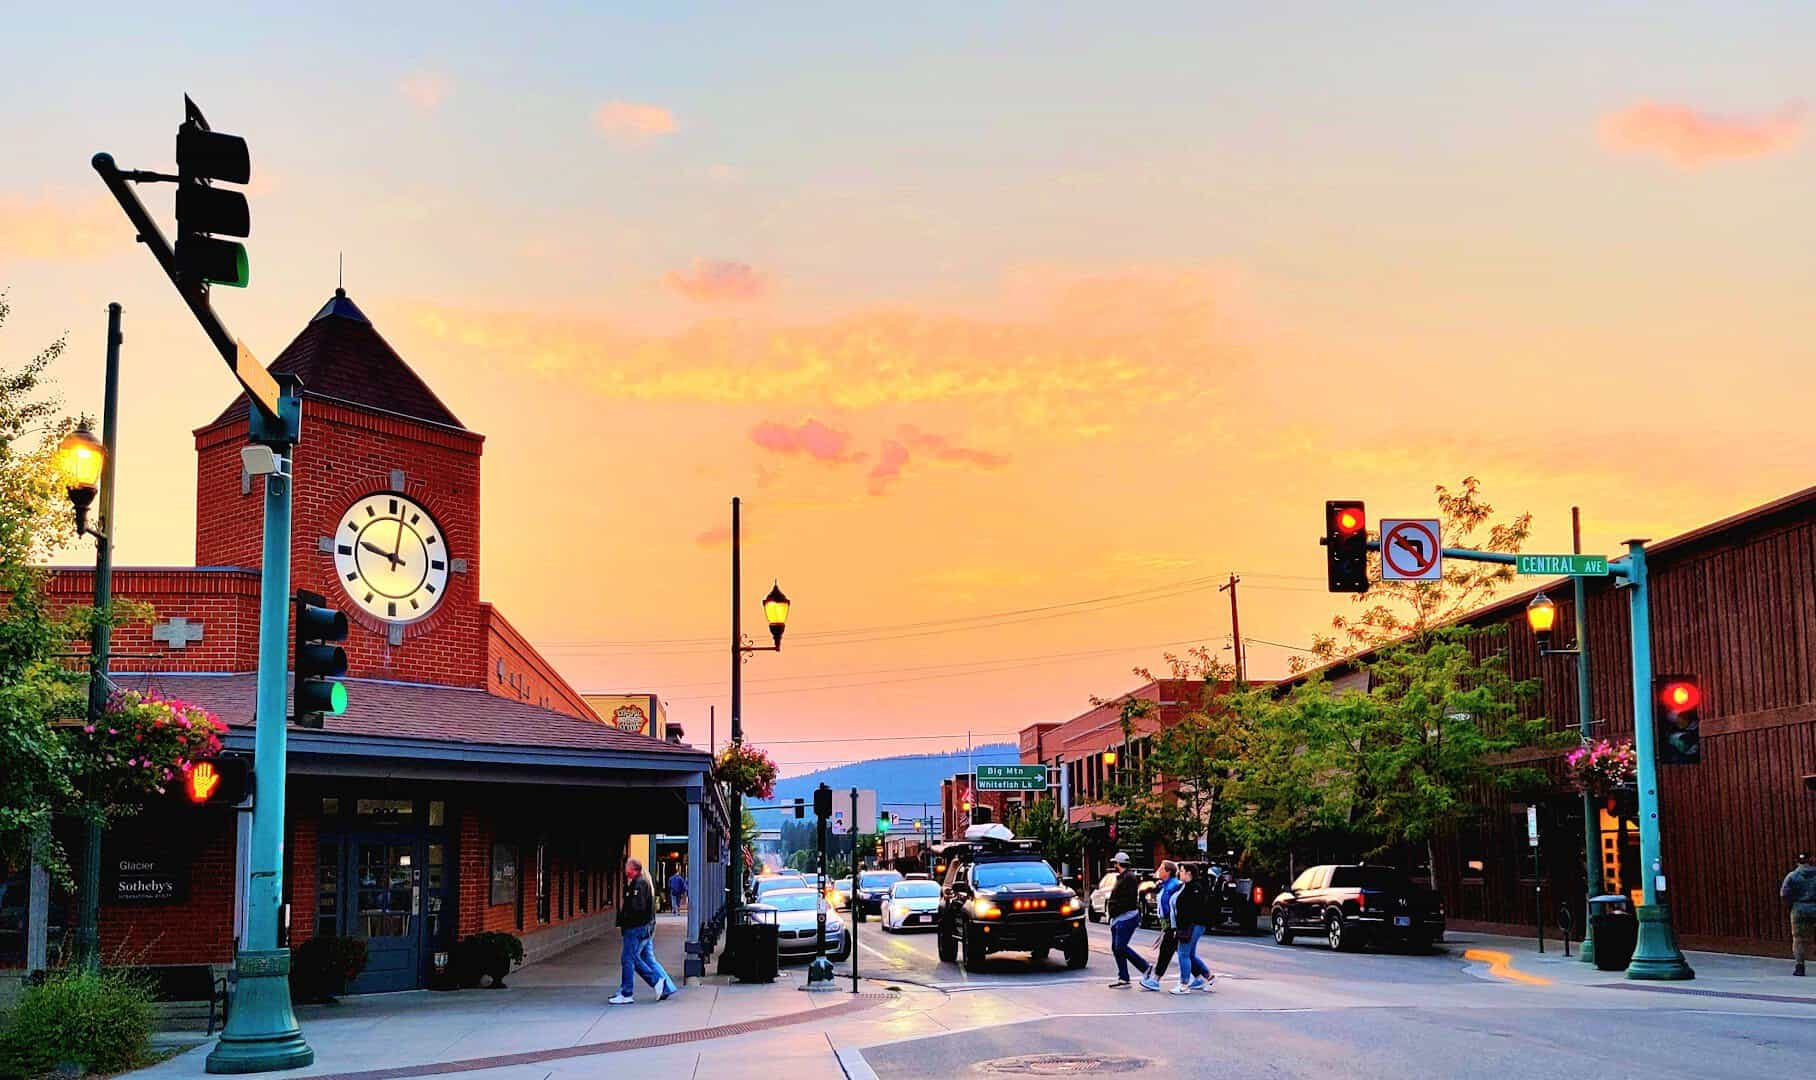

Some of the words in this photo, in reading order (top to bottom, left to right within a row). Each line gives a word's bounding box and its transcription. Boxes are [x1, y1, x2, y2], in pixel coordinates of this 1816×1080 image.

[1522, 556, 1576, 572] CENTRAL
[1584, 560, 1603, 573] AVE
[987, 767, 1002, 776] Big
[1006, 767, 1024, 775] Mtn
[979, 780, 1019, 788] Whitefish
[1021, 780, 1033, 788] Lk
[119, 860, 154, 870] Glacier
[118, 880, 173, 893] Sotheby's
